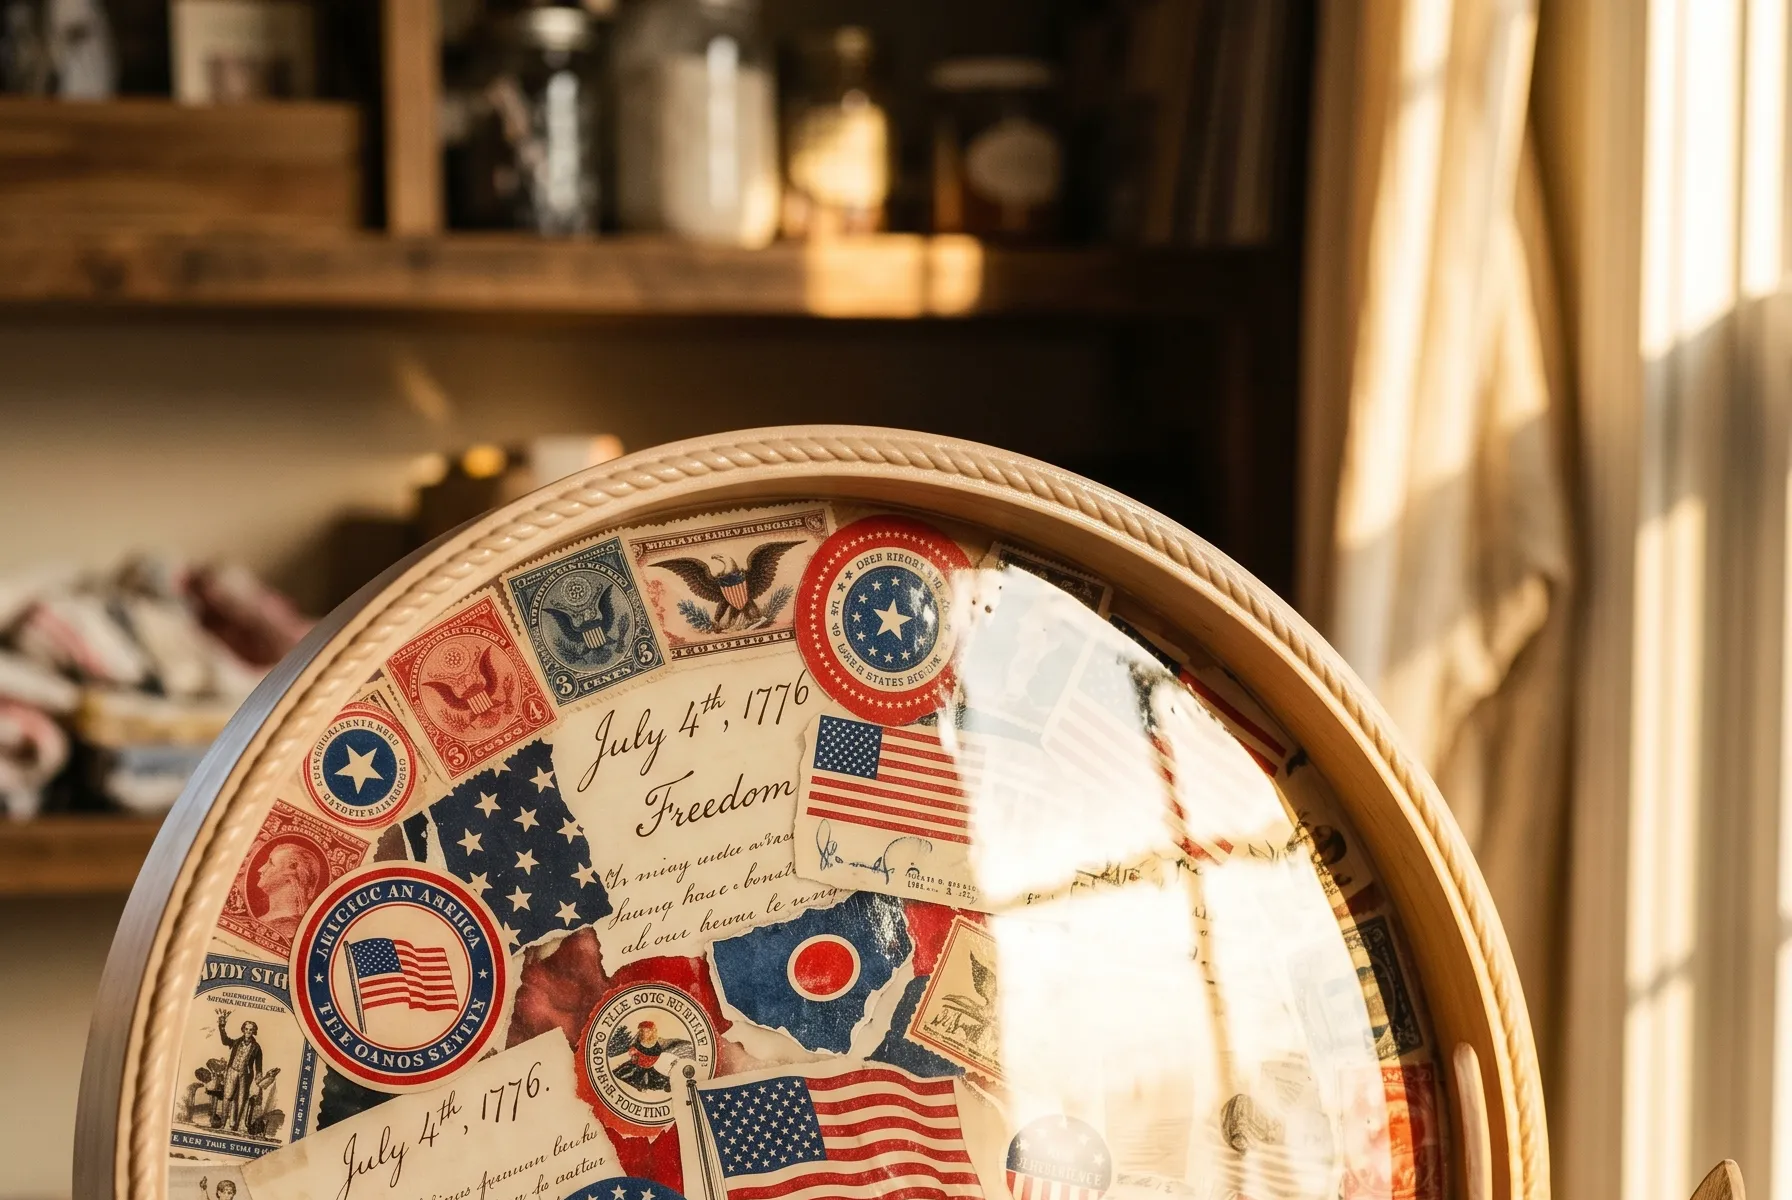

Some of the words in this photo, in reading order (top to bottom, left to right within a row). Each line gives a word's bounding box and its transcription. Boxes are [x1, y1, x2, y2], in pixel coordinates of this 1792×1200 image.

[865, 672, 904, 687] STATES
[576, 708, 667, 792] July
[743, 669, 809, 726] 1776
[636, 770, 796, 837] Freedom
[481, 1061, 550, 1123] 1776.
